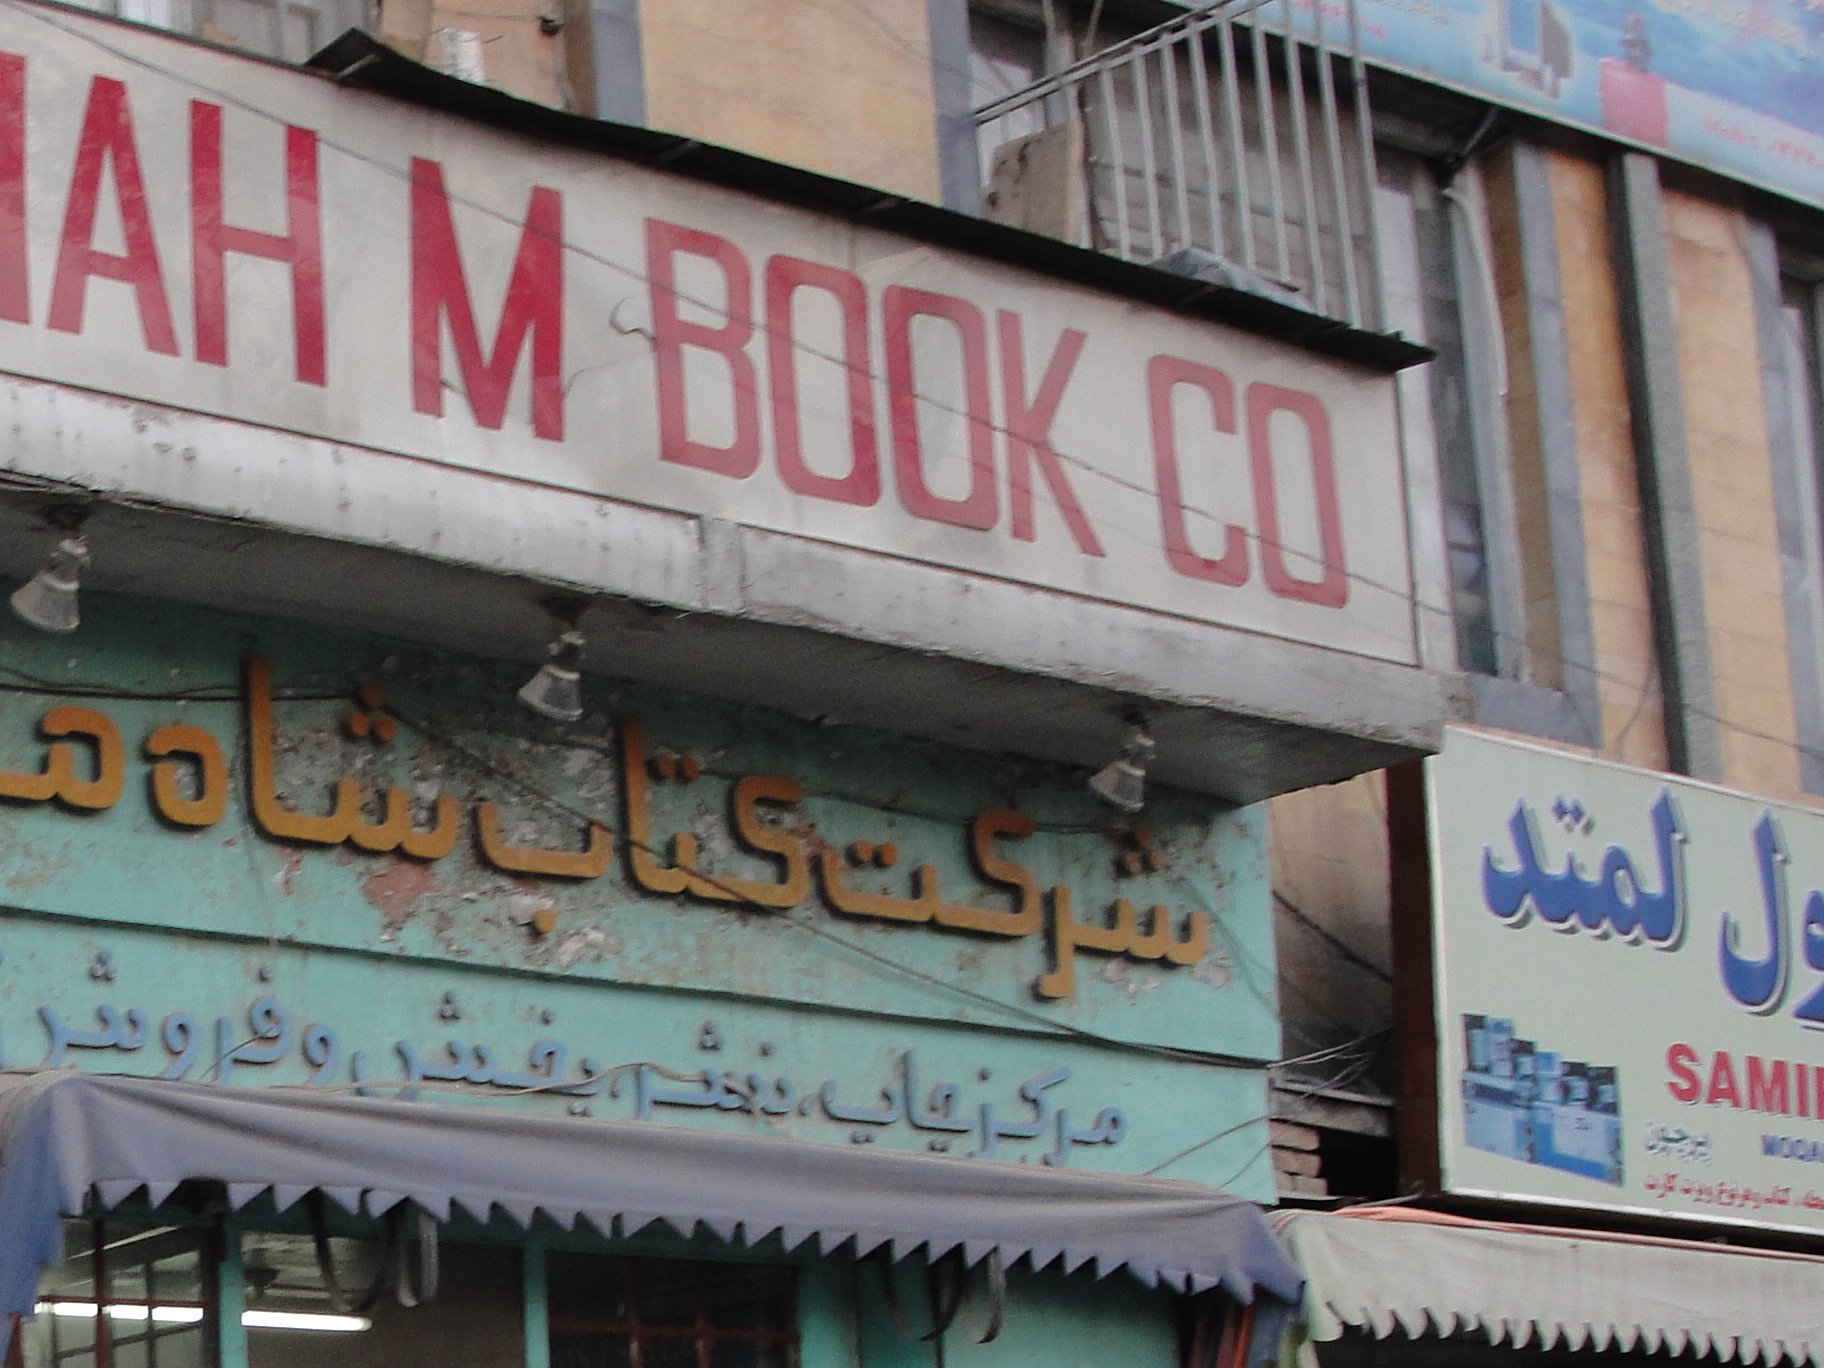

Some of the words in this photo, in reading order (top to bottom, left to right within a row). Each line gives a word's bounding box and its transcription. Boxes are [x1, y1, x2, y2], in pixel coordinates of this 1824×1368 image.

[409, 156, 565, 442] M
[644, 217, 1106, 558] BOOK
[1146, 354, 1347, 608] CO
[142, 655, 460, 861] شاه
[478, 719, 809, 933] کتاب
[819, 810, 1212, 998] شرکت
